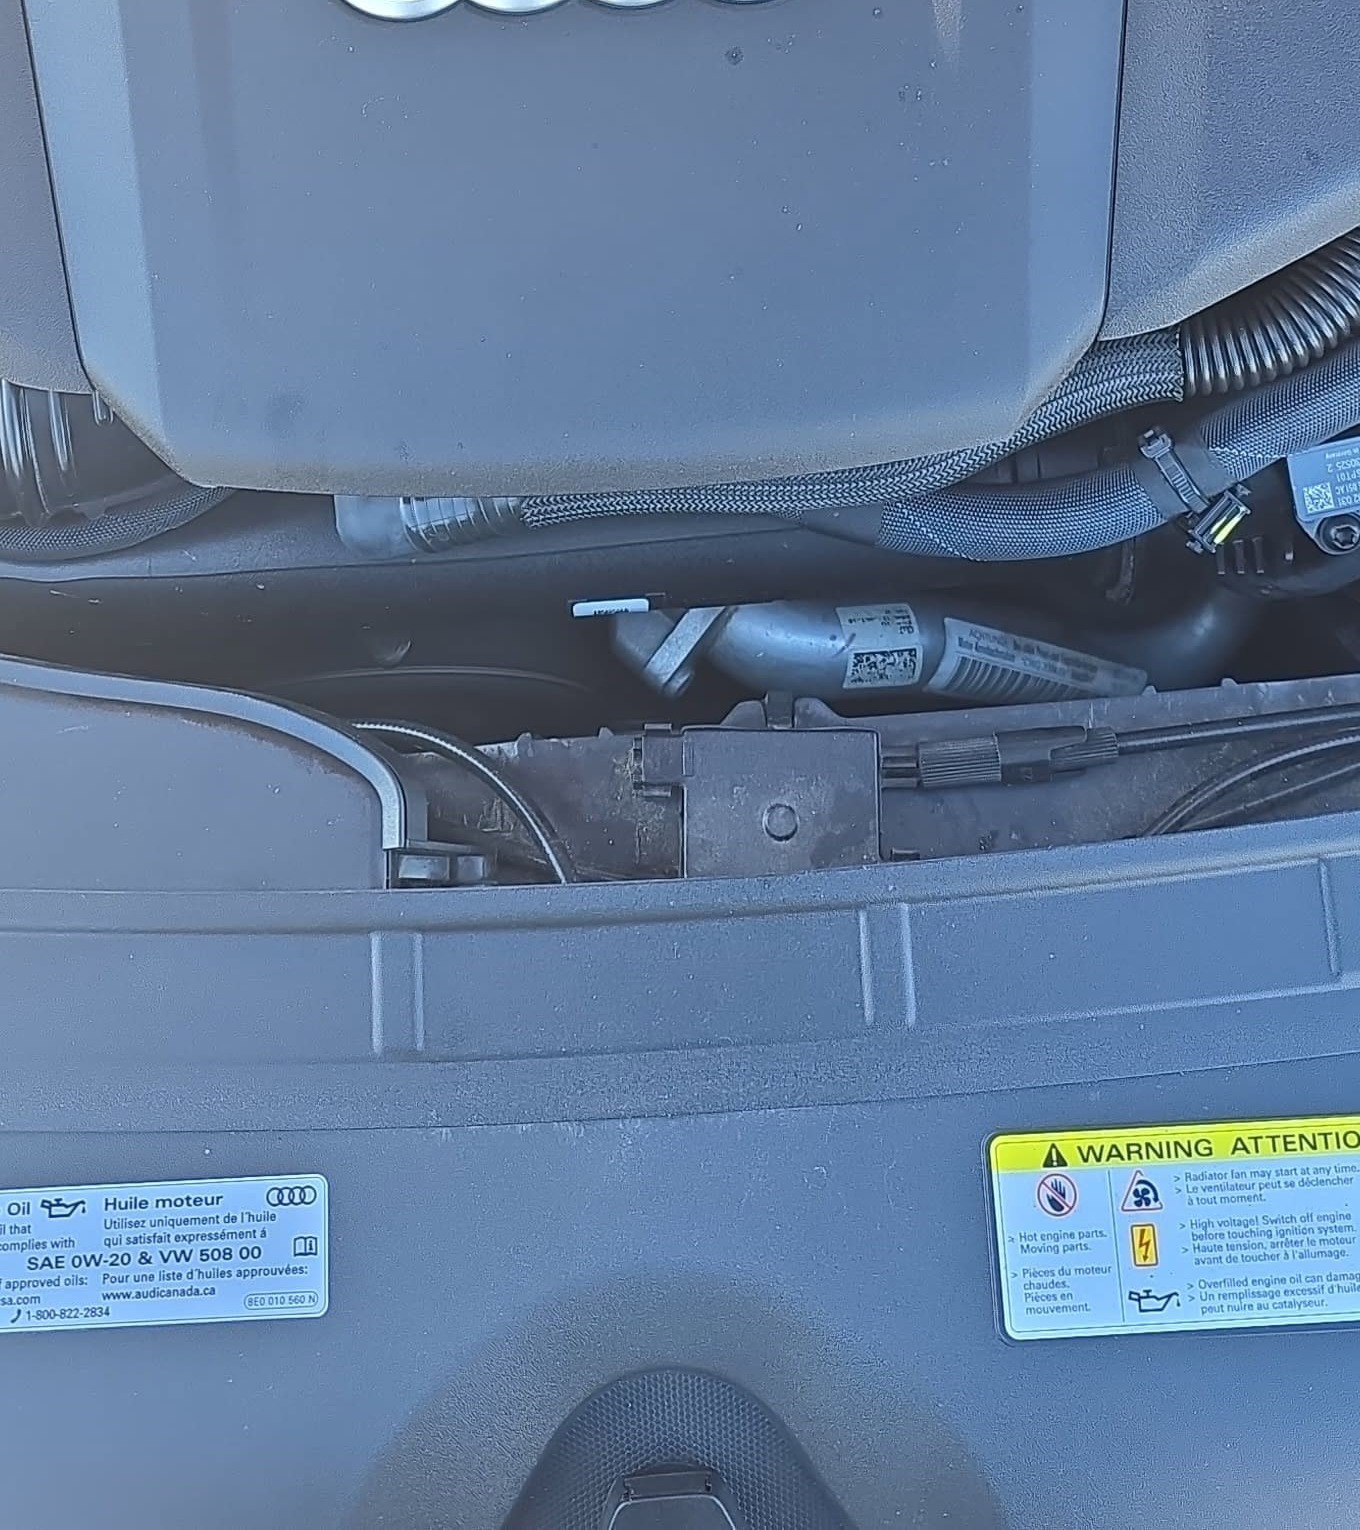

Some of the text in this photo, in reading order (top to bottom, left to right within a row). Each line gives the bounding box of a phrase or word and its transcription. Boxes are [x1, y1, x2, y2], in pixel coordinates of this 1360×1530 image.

[1076, 1137, 1213, 1163] WARNING
[1184, 1169, 1228, 1182] Radiator
[1249, 1169, 1272, 1180] may
[1274, 1166, 1298, 1177] start
[1312, 1165, 1332, 1176] any
[1333, 1162, 1360, 1174] time.
[1199, 1180, 1256, 1193] ventilateur
[1257, 1179, 1282, 1192] peut
[103, 1194, 223, 1211] Huile moteur
[1195, 1195, 1218, 1205] tout
[1219, 1192, 1266, 1204] moment.
[6, 1201, 30, 1216] Oil
[8, 1222, 31, 1235] that
[103, 1216, 146, 1230] Utilisez
[148, 1214, 220, 1229] uniquement
[222, 1211, 237, 1224] de
[1189, 1217, 1215, 1231] High
[1215, 1214, 1259, 1229] voltage!
[1261, 1213, 1297, 1225] Switch
[1315, 1210, 1352, 1224] engine
[103, 1233, 122, 1249] qui
[125, 1231, 171, 1245] satisfait
[173, 1228, 257, 1245] expressément
[1018, 1228, 1107, 1243] Hot engine parts.
[1190, 1223, 1357, 1242] before touching ignition system.
[49, 1236, 75, 1249] with
[1019, 1241, 1092, 1254] Moving parts.
[1191, 1242, 1223, 1254] Haute
[1224, 1239, 1267, 1252] tension,
[1318, 1235, 1356, 1246] moteur
[26, 1245, 262, 1271] SAE 0W-20 & VW 508 00
[1193, 1254, 1223, 1266] avant
[1240, 1251, 1280, 1263] toucher
[101, 1272, 130, 1285] Pour
[132, 1272, 155, 1283] une
[158, 1269, 183, 1282] liste
[235, 1262, 308, 1280] approuvées:
[1073, 1265, 1112, 1275] moteur
[4, 1274, 61, 1292] approved
[63, 1273, 88, 1286] oils:
[1022, 1278, 1070, 1290] chaudes.
[1197, 1275, 1248, 1290] Overfilled
[1250, 1274, 1287, 1288] engine
[1303, 1274, 1323, 1283] can
[101, 1284, 216, 1301] www.audicanada.ca
[1217, 1287, 1281, 1302] remplissage
[1282, 1283, 1325, 1297] excessif
[25, 1305, 110, 1321] 1-800-822-2834
[1025, 1301, 1091, 1315] mouvement.
[1200, 1303, 1224, 1316] peut
[1226, 1299, 1254, 1312] nuire
[1271, 1297, 1328, 1310] catalyseur.
